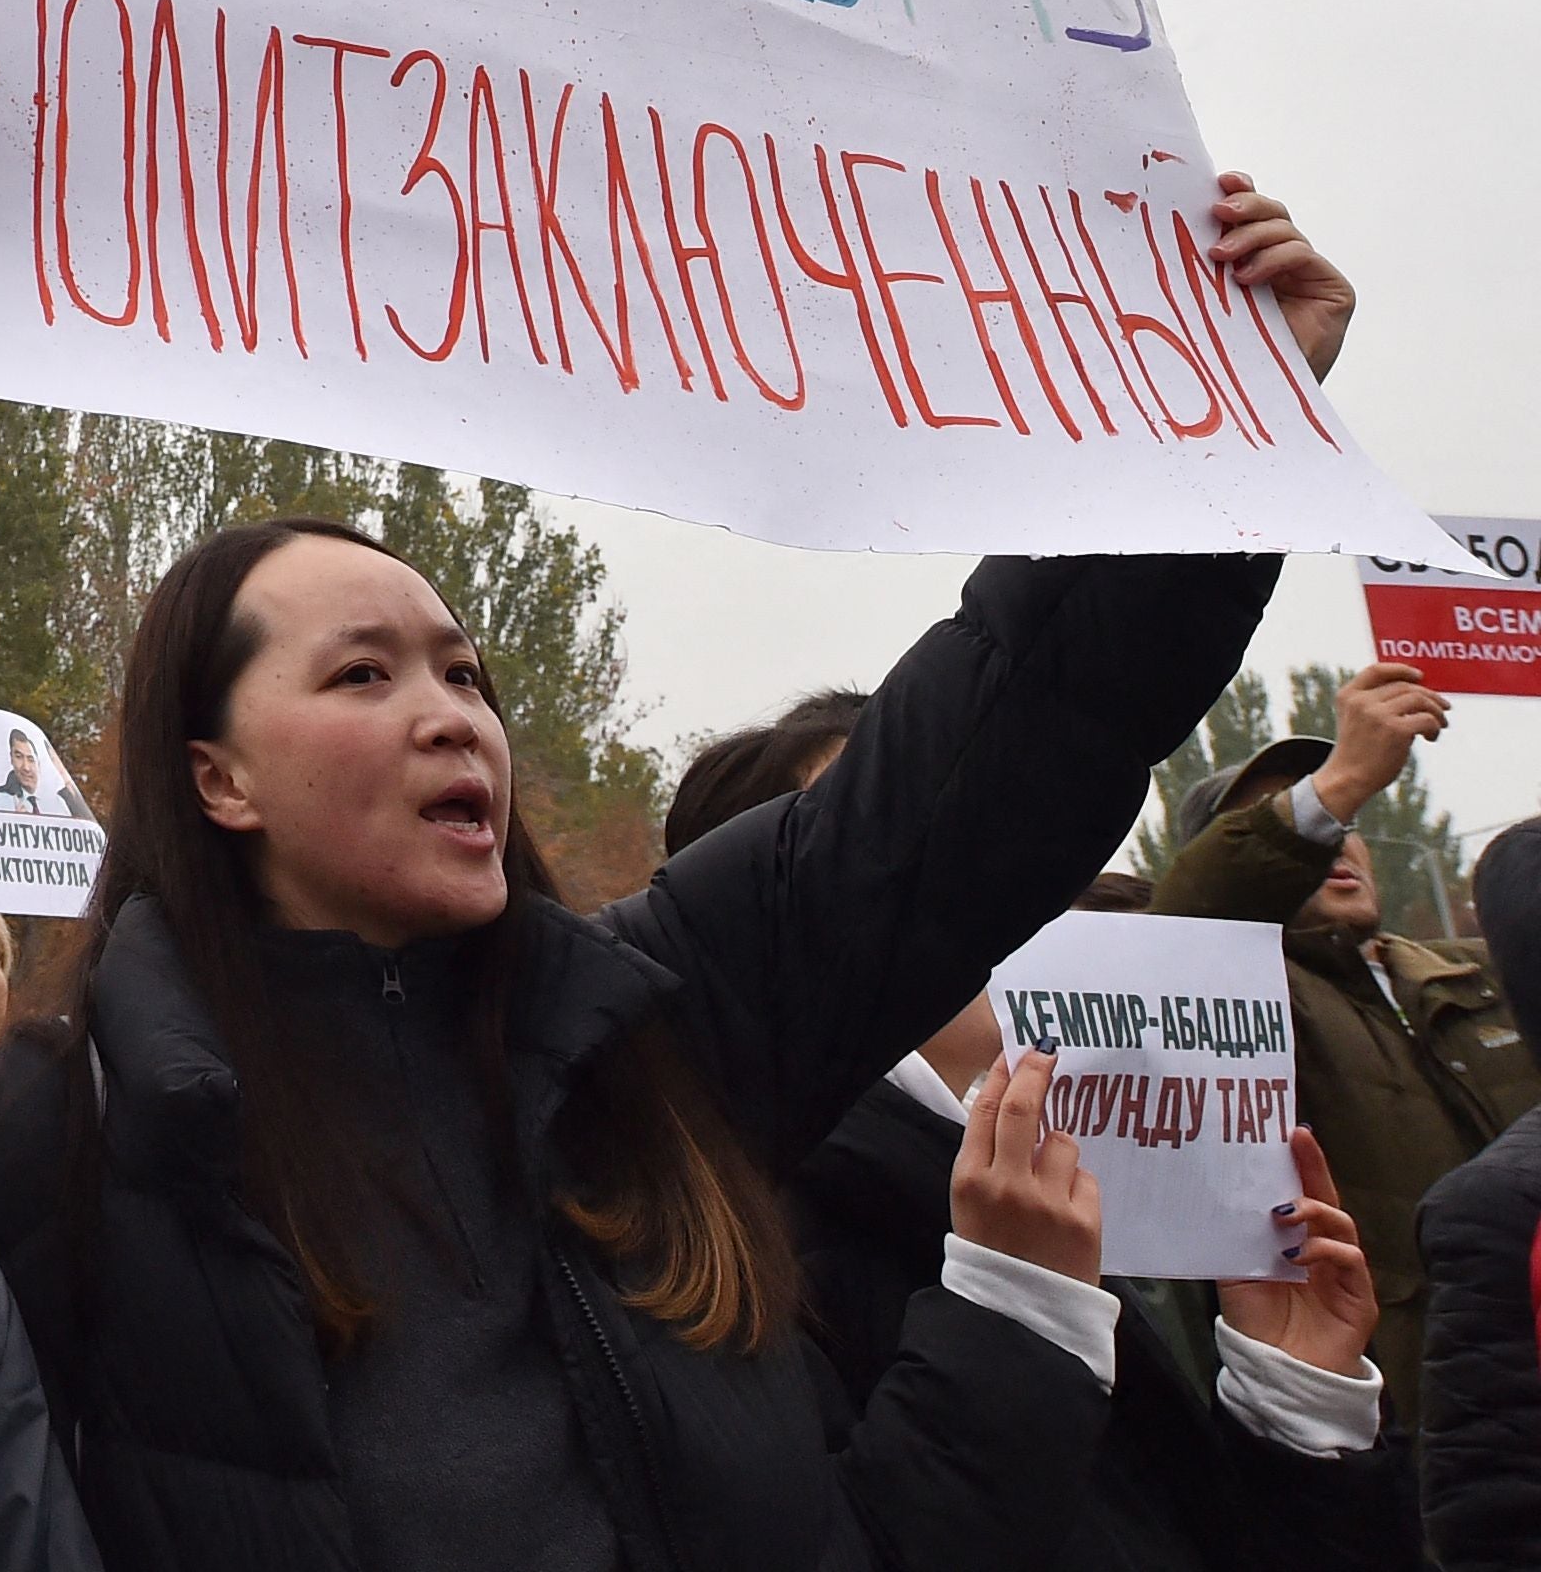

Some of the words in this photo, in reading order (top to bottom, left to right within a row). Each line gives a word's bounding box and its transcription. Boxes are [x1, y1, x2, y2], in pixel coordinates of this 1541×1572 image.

[1454, 606, 1541, 636] ВСЕМ
[1005, 989, 1287, 1059] КЕМПИР-АБАДДАН
[1216, 1078, 1288, 1144] ТАРТ
